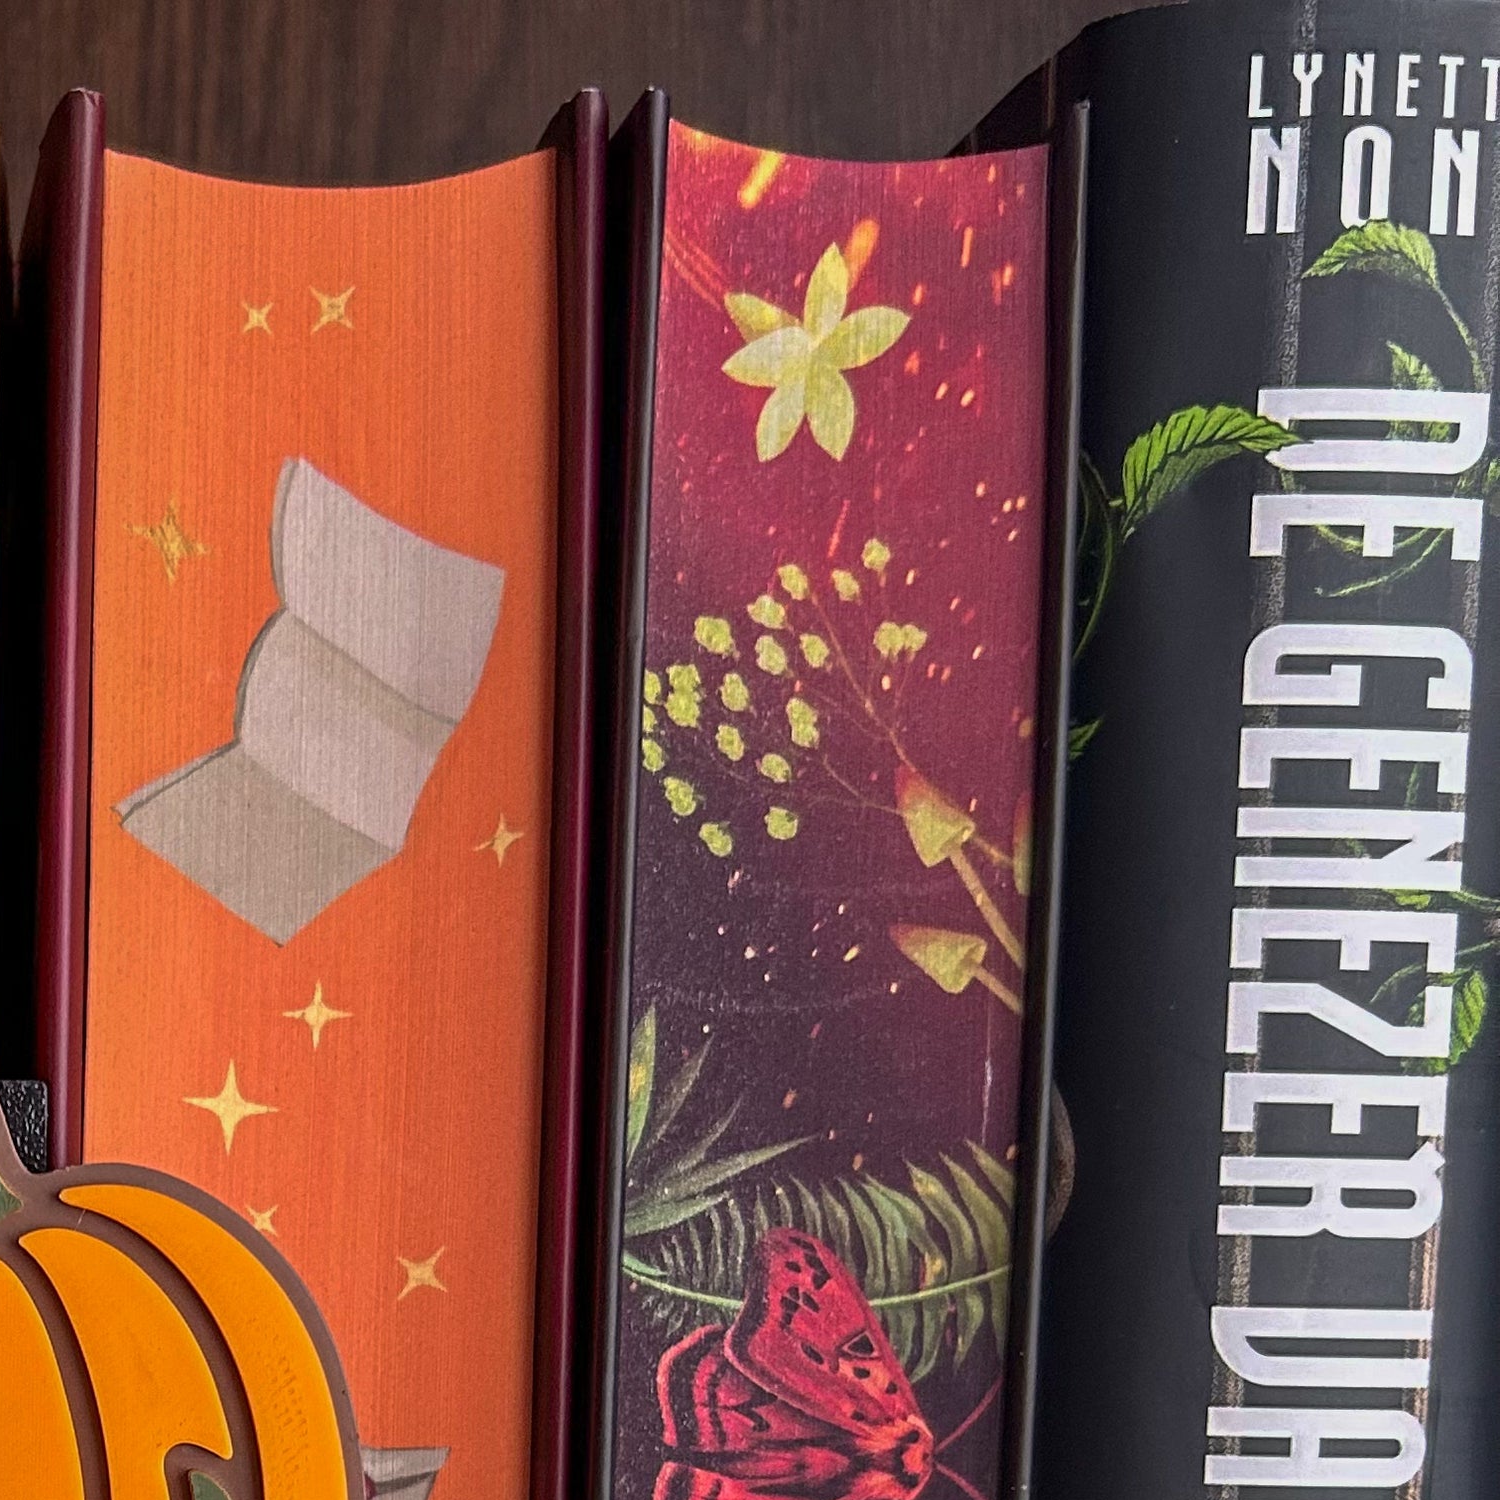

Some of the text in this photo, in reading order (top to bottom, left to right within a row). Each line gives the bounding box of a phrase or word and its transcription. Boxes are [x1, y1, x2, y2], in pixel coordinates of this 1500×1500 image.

[1246, 125, 1480, 236] NON
[1249, 388, 1490, 561] DE
[1216, 623, 1474, 1238] GENEZER
